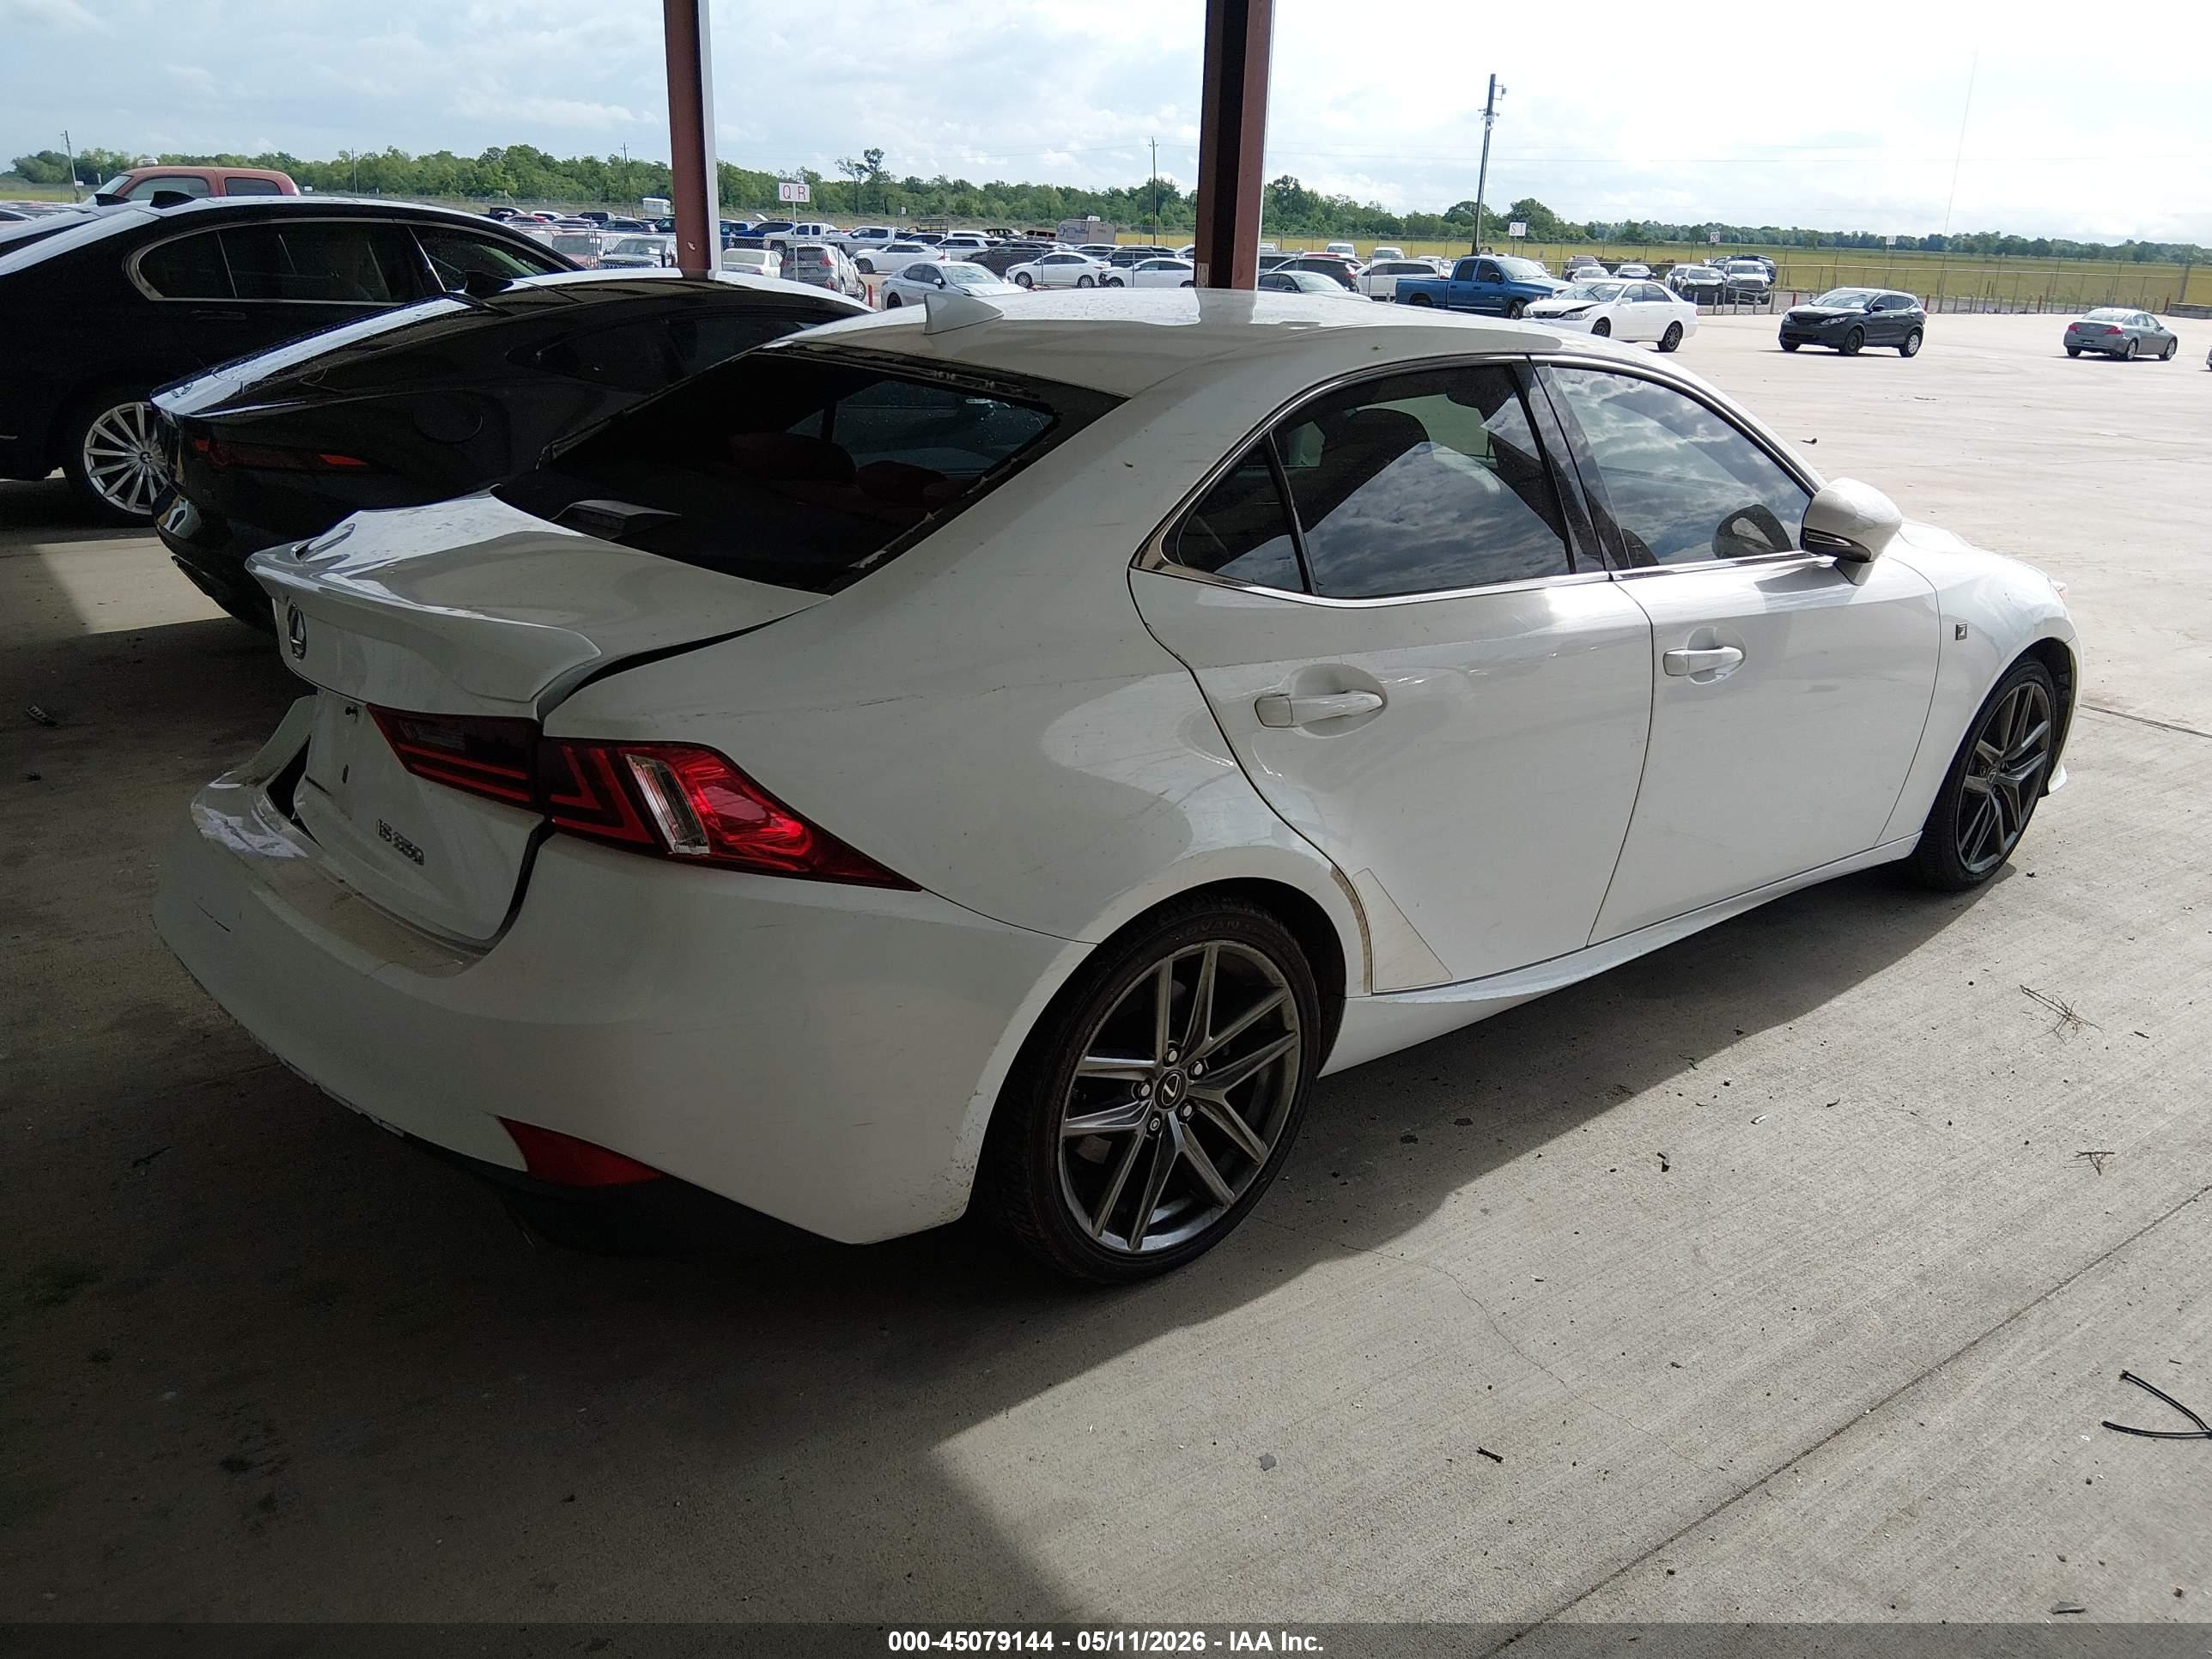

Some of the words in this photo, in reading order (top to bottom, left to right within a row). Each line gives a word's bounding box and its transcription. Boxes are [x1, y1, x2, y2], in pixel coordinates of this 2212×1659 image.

[782, 185, 792, 200] Q
[798, 185, 806, 200] R
[1511, 223, 1516, 234] S
[1711, 233, 1719, 241] 20
